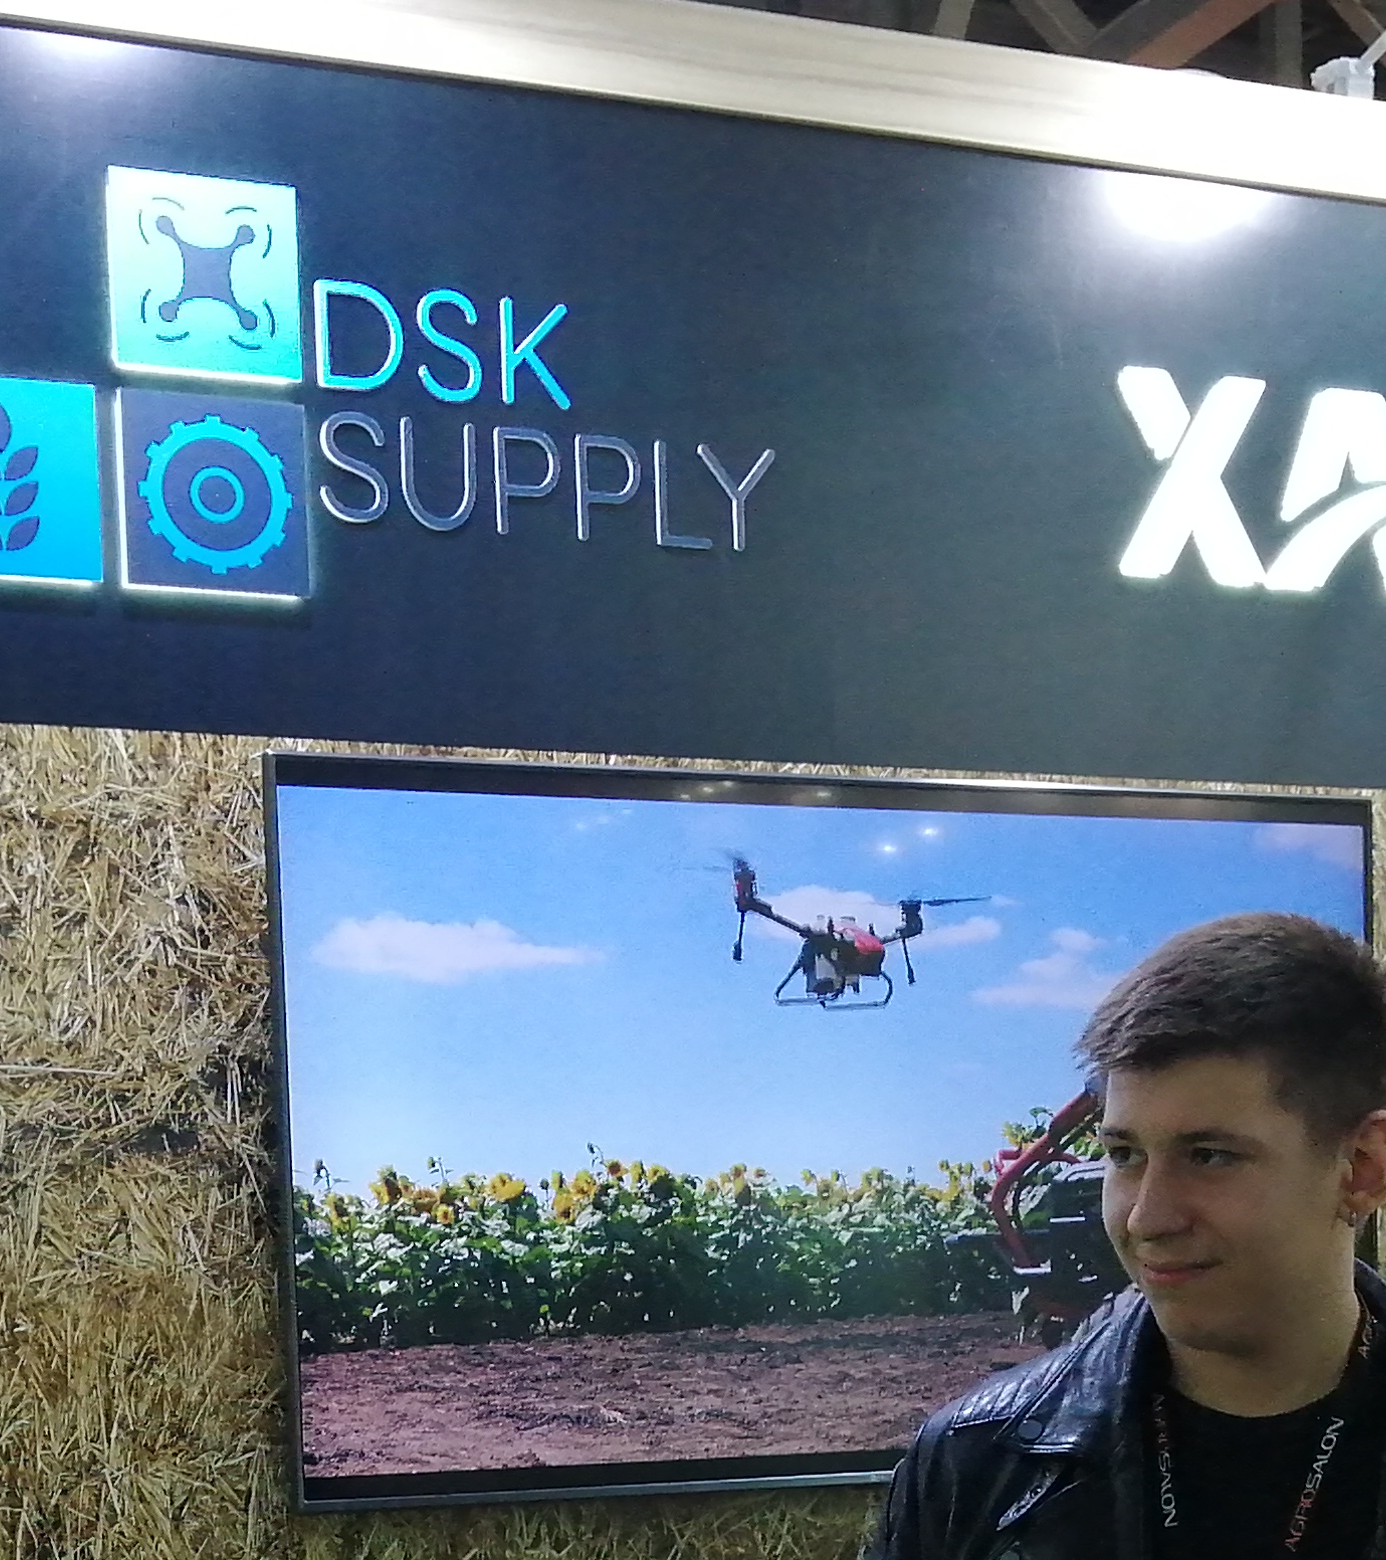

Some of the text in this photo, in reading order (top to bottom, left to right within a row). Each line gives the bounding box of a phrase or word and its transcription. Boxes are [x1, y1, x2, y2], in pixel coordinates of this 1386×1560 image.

[313, 278, 572, 410] DSK
[317, 411, 776, 553] SUPPLY
[1284, 1414, 1346, 1553] AGROSALON
